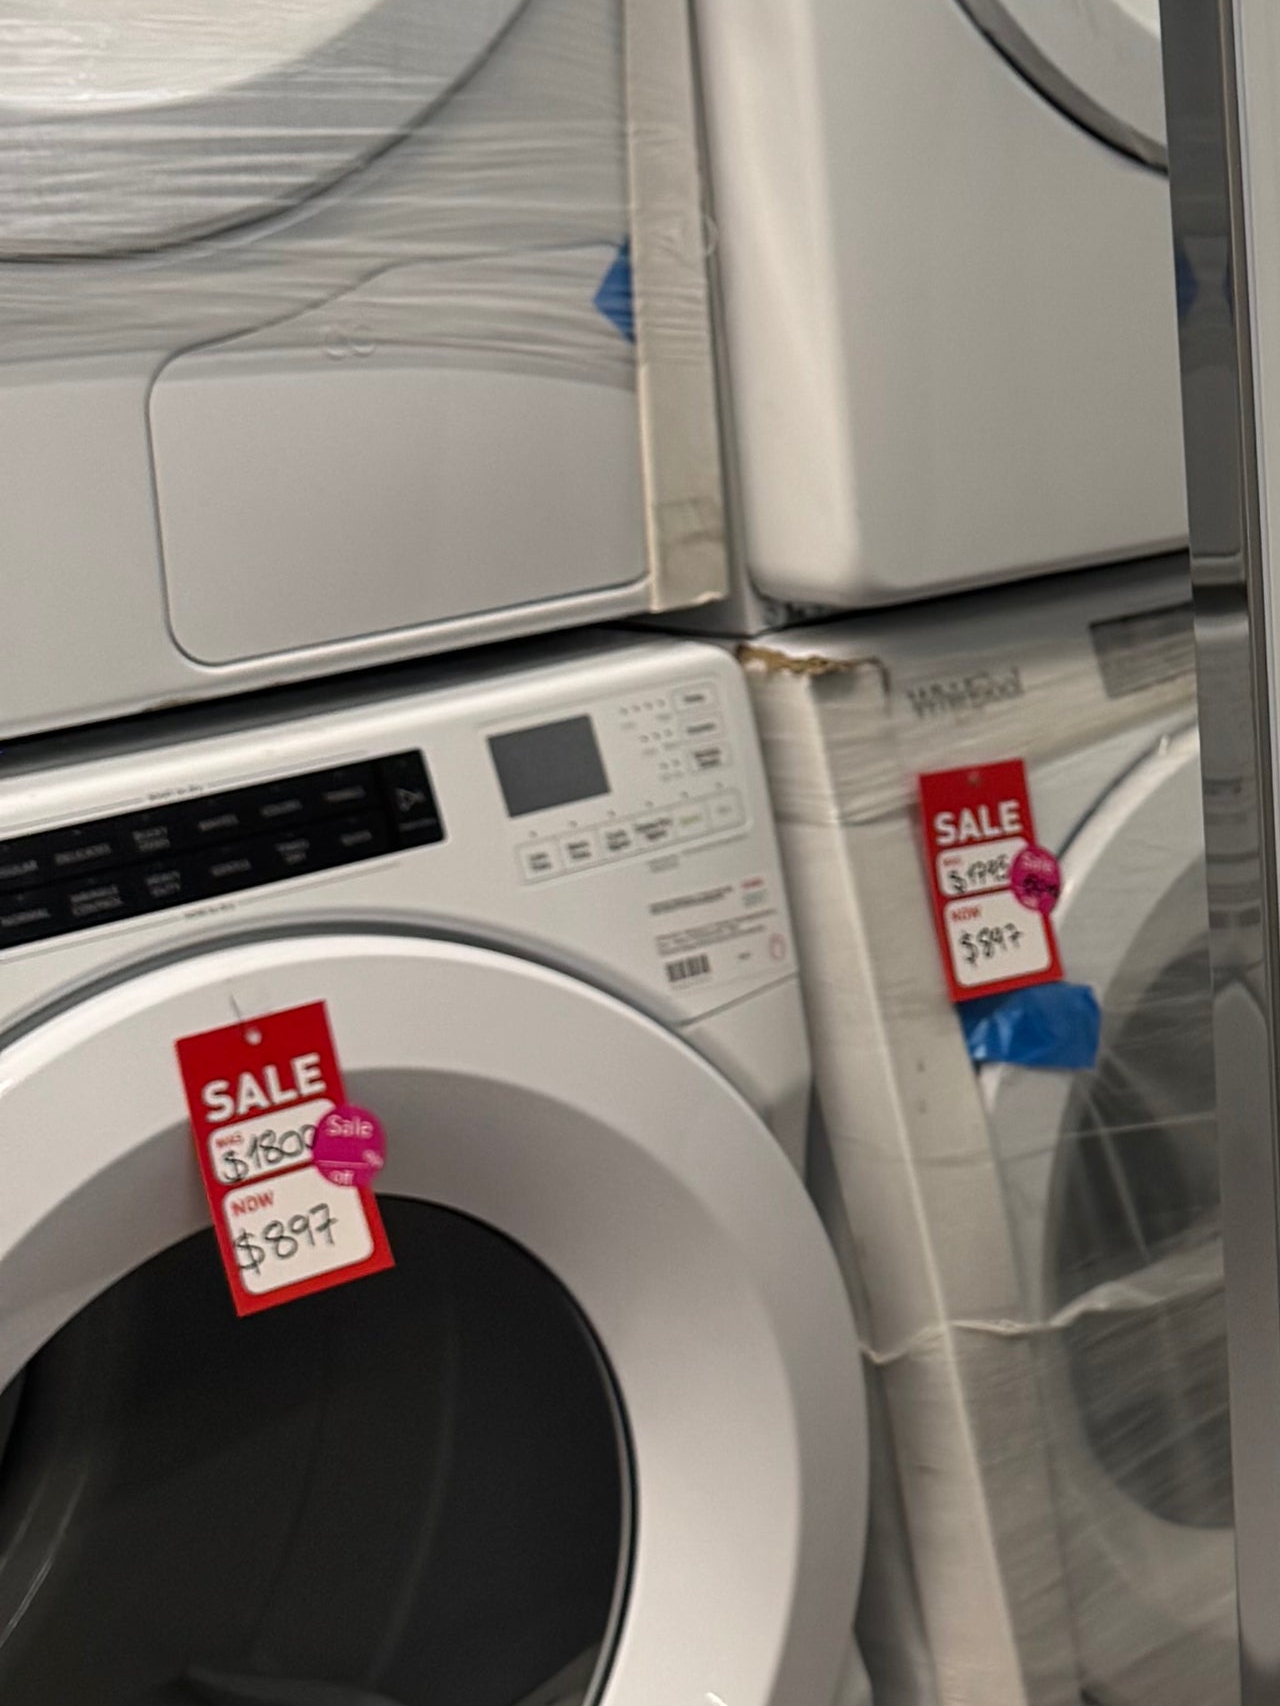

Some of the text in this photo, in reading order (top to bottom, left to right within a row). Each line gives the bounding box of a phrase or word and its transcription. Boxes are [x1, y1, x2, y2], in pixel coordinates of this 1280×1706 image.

[933, 799, 1024, 845] SALE
[203, 1052, 327, 1123] SALE
[326, 1113, 374, 1138] Sale
[229, 1189, 275, 1217] NOW
[232, 1202, 338, 1277] $897
